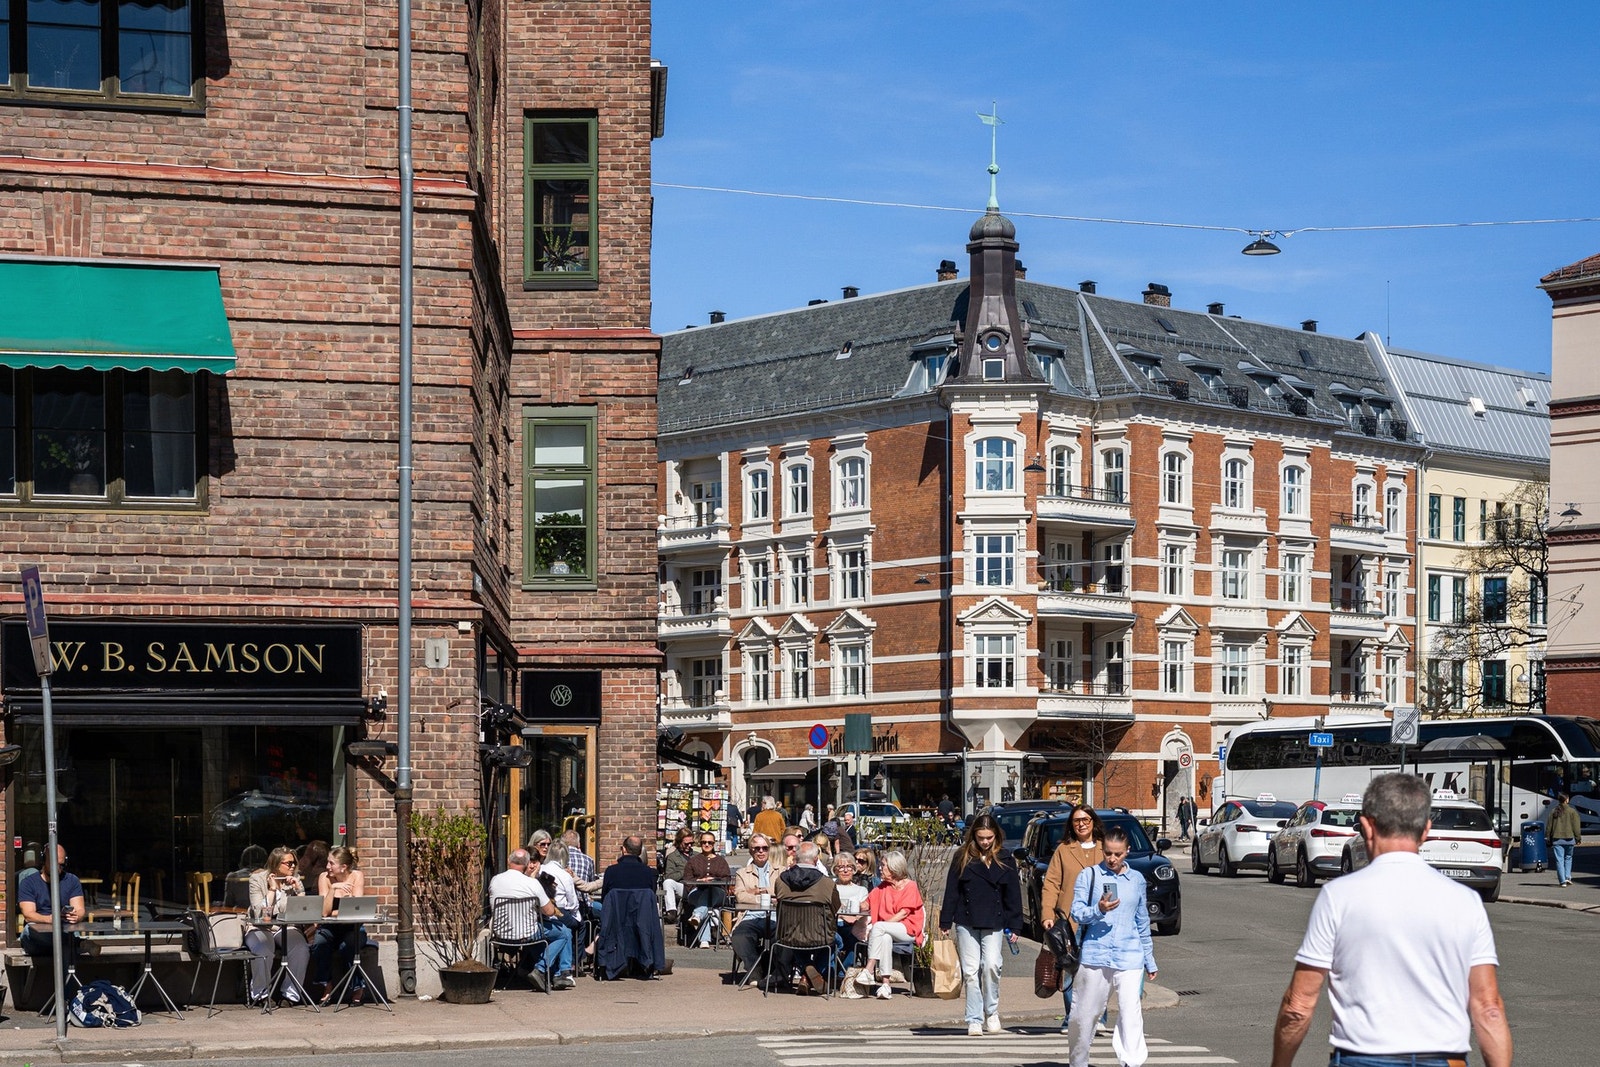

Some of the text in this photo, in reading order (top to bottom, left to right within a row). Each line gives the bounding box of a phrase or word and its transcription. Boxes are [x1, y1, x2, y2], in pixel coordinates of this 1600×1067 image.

[26, 577, 39, 628] P
[49, 641, 326, 674] W. B. SAMSON
[1313, 735, 1330, 743] Taxi
[1182, 756, 1189, 764] 30
